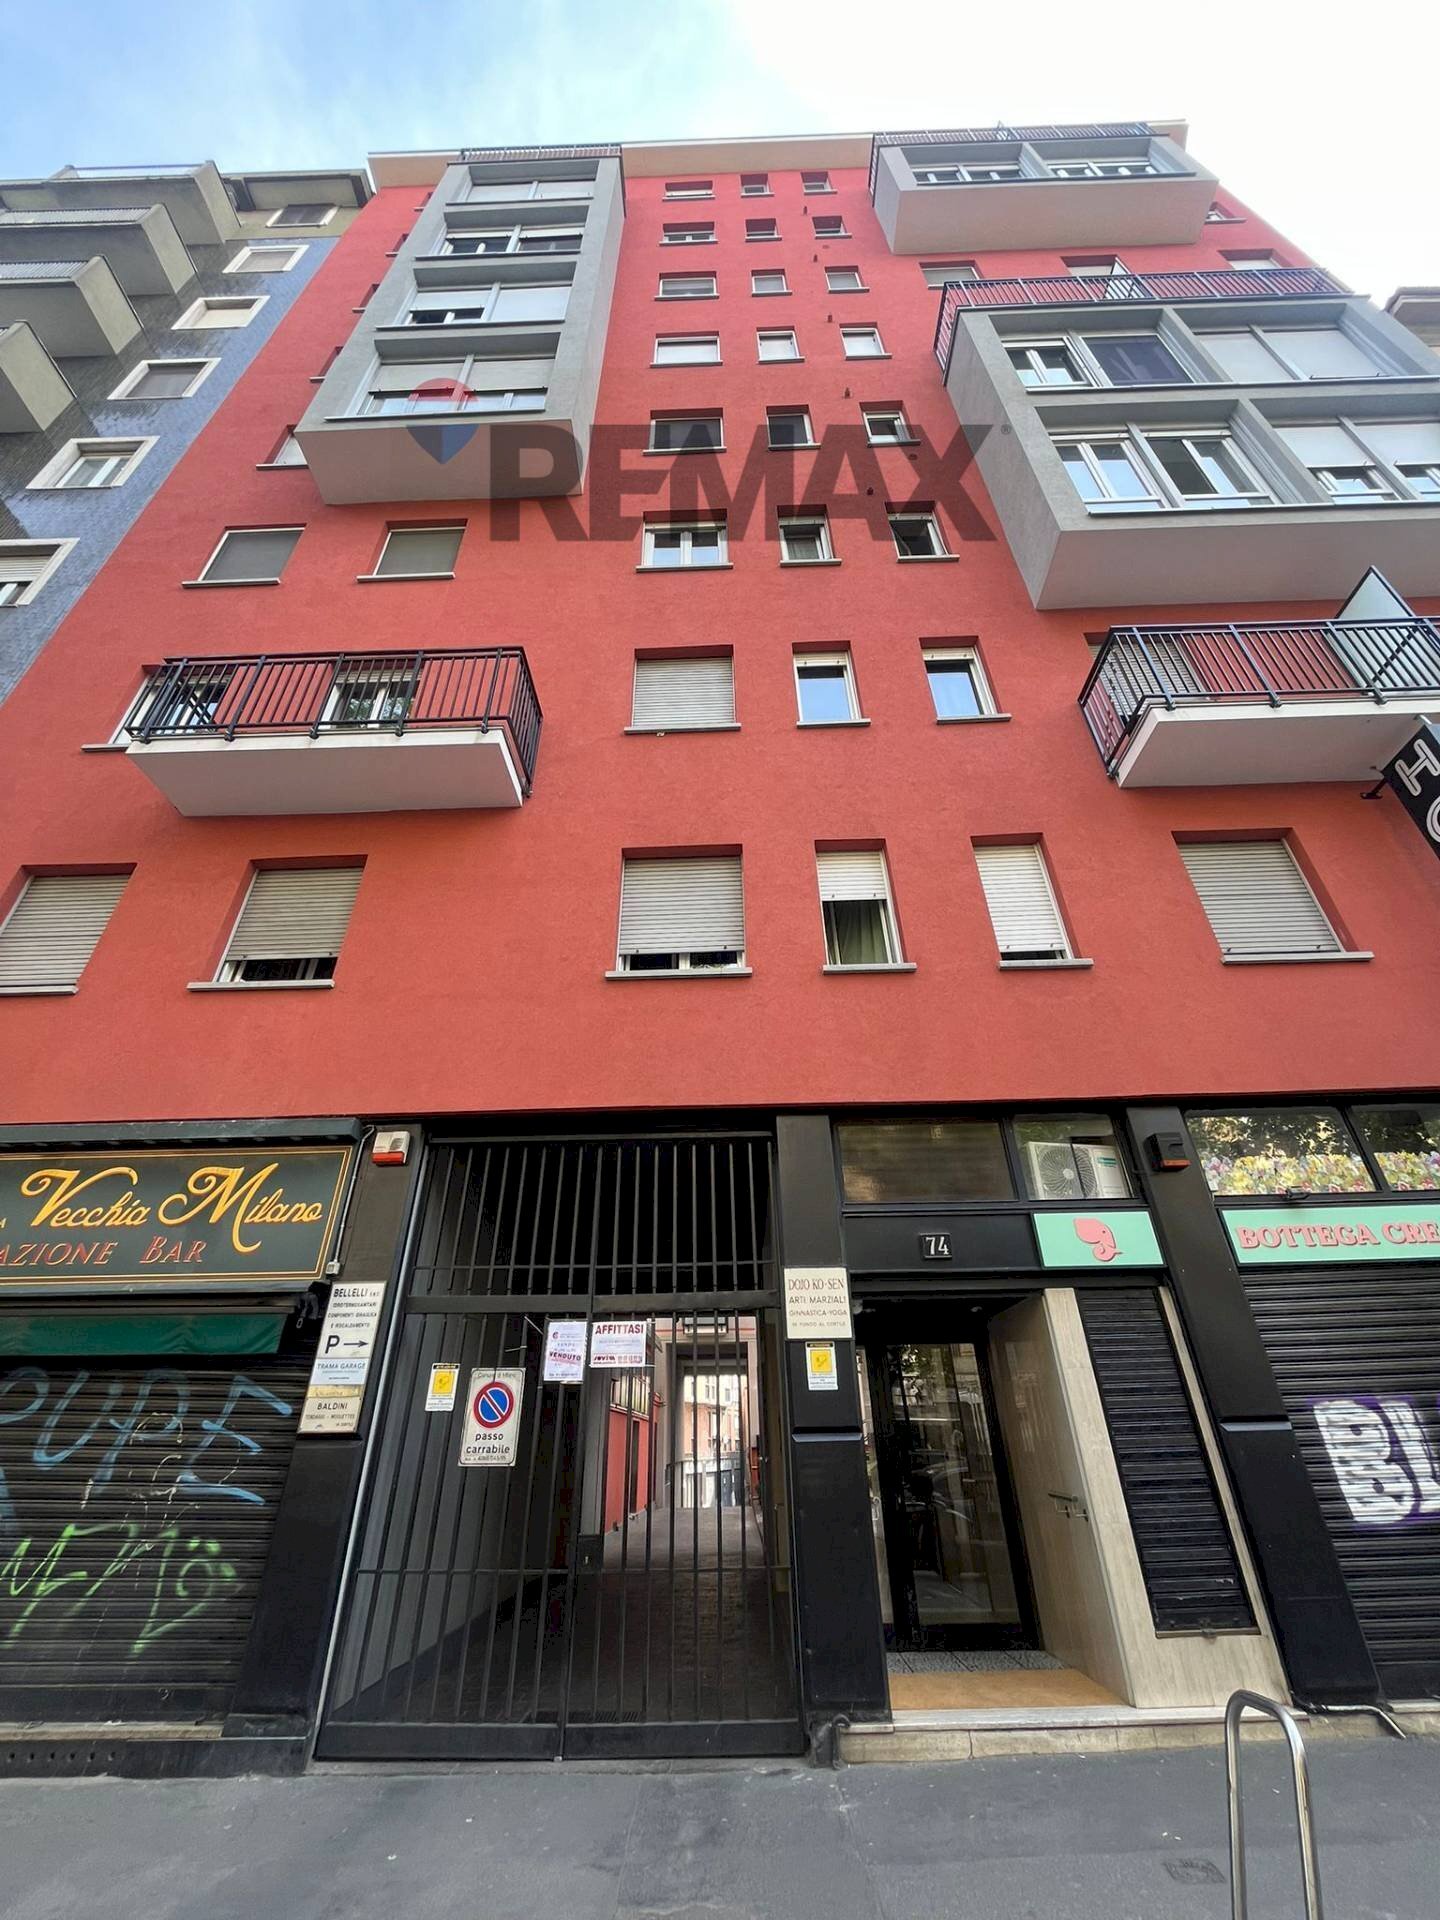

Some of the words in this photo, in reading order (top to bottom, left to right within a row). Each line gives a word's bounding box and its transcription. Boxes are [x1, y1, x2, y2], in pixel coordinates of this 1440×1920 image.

[20, 1166, 152, 1228] Vecchia
[157, 1162, 323, 1254] Milano
[1237, 1223, 1381, 1250] BOTTEGA
[926, 1236, 950, 1256] 74
[788, 1279, 810, 1291] DOJO
[333, 1288, 368, 1298] BELLELLI
[789, 1295, 807, 1304] ARTI
[809, 1295, 846, 1304] MARZIALI
[595, 1324, 644, 1335] AFFITTASI
[325, 1335, 340, 1354] P
[549, 1351, 581, 1361] VENDUTO
[475, 1433, 504, 1442] passo
[466, 1444, 510, 1454] carrabile
